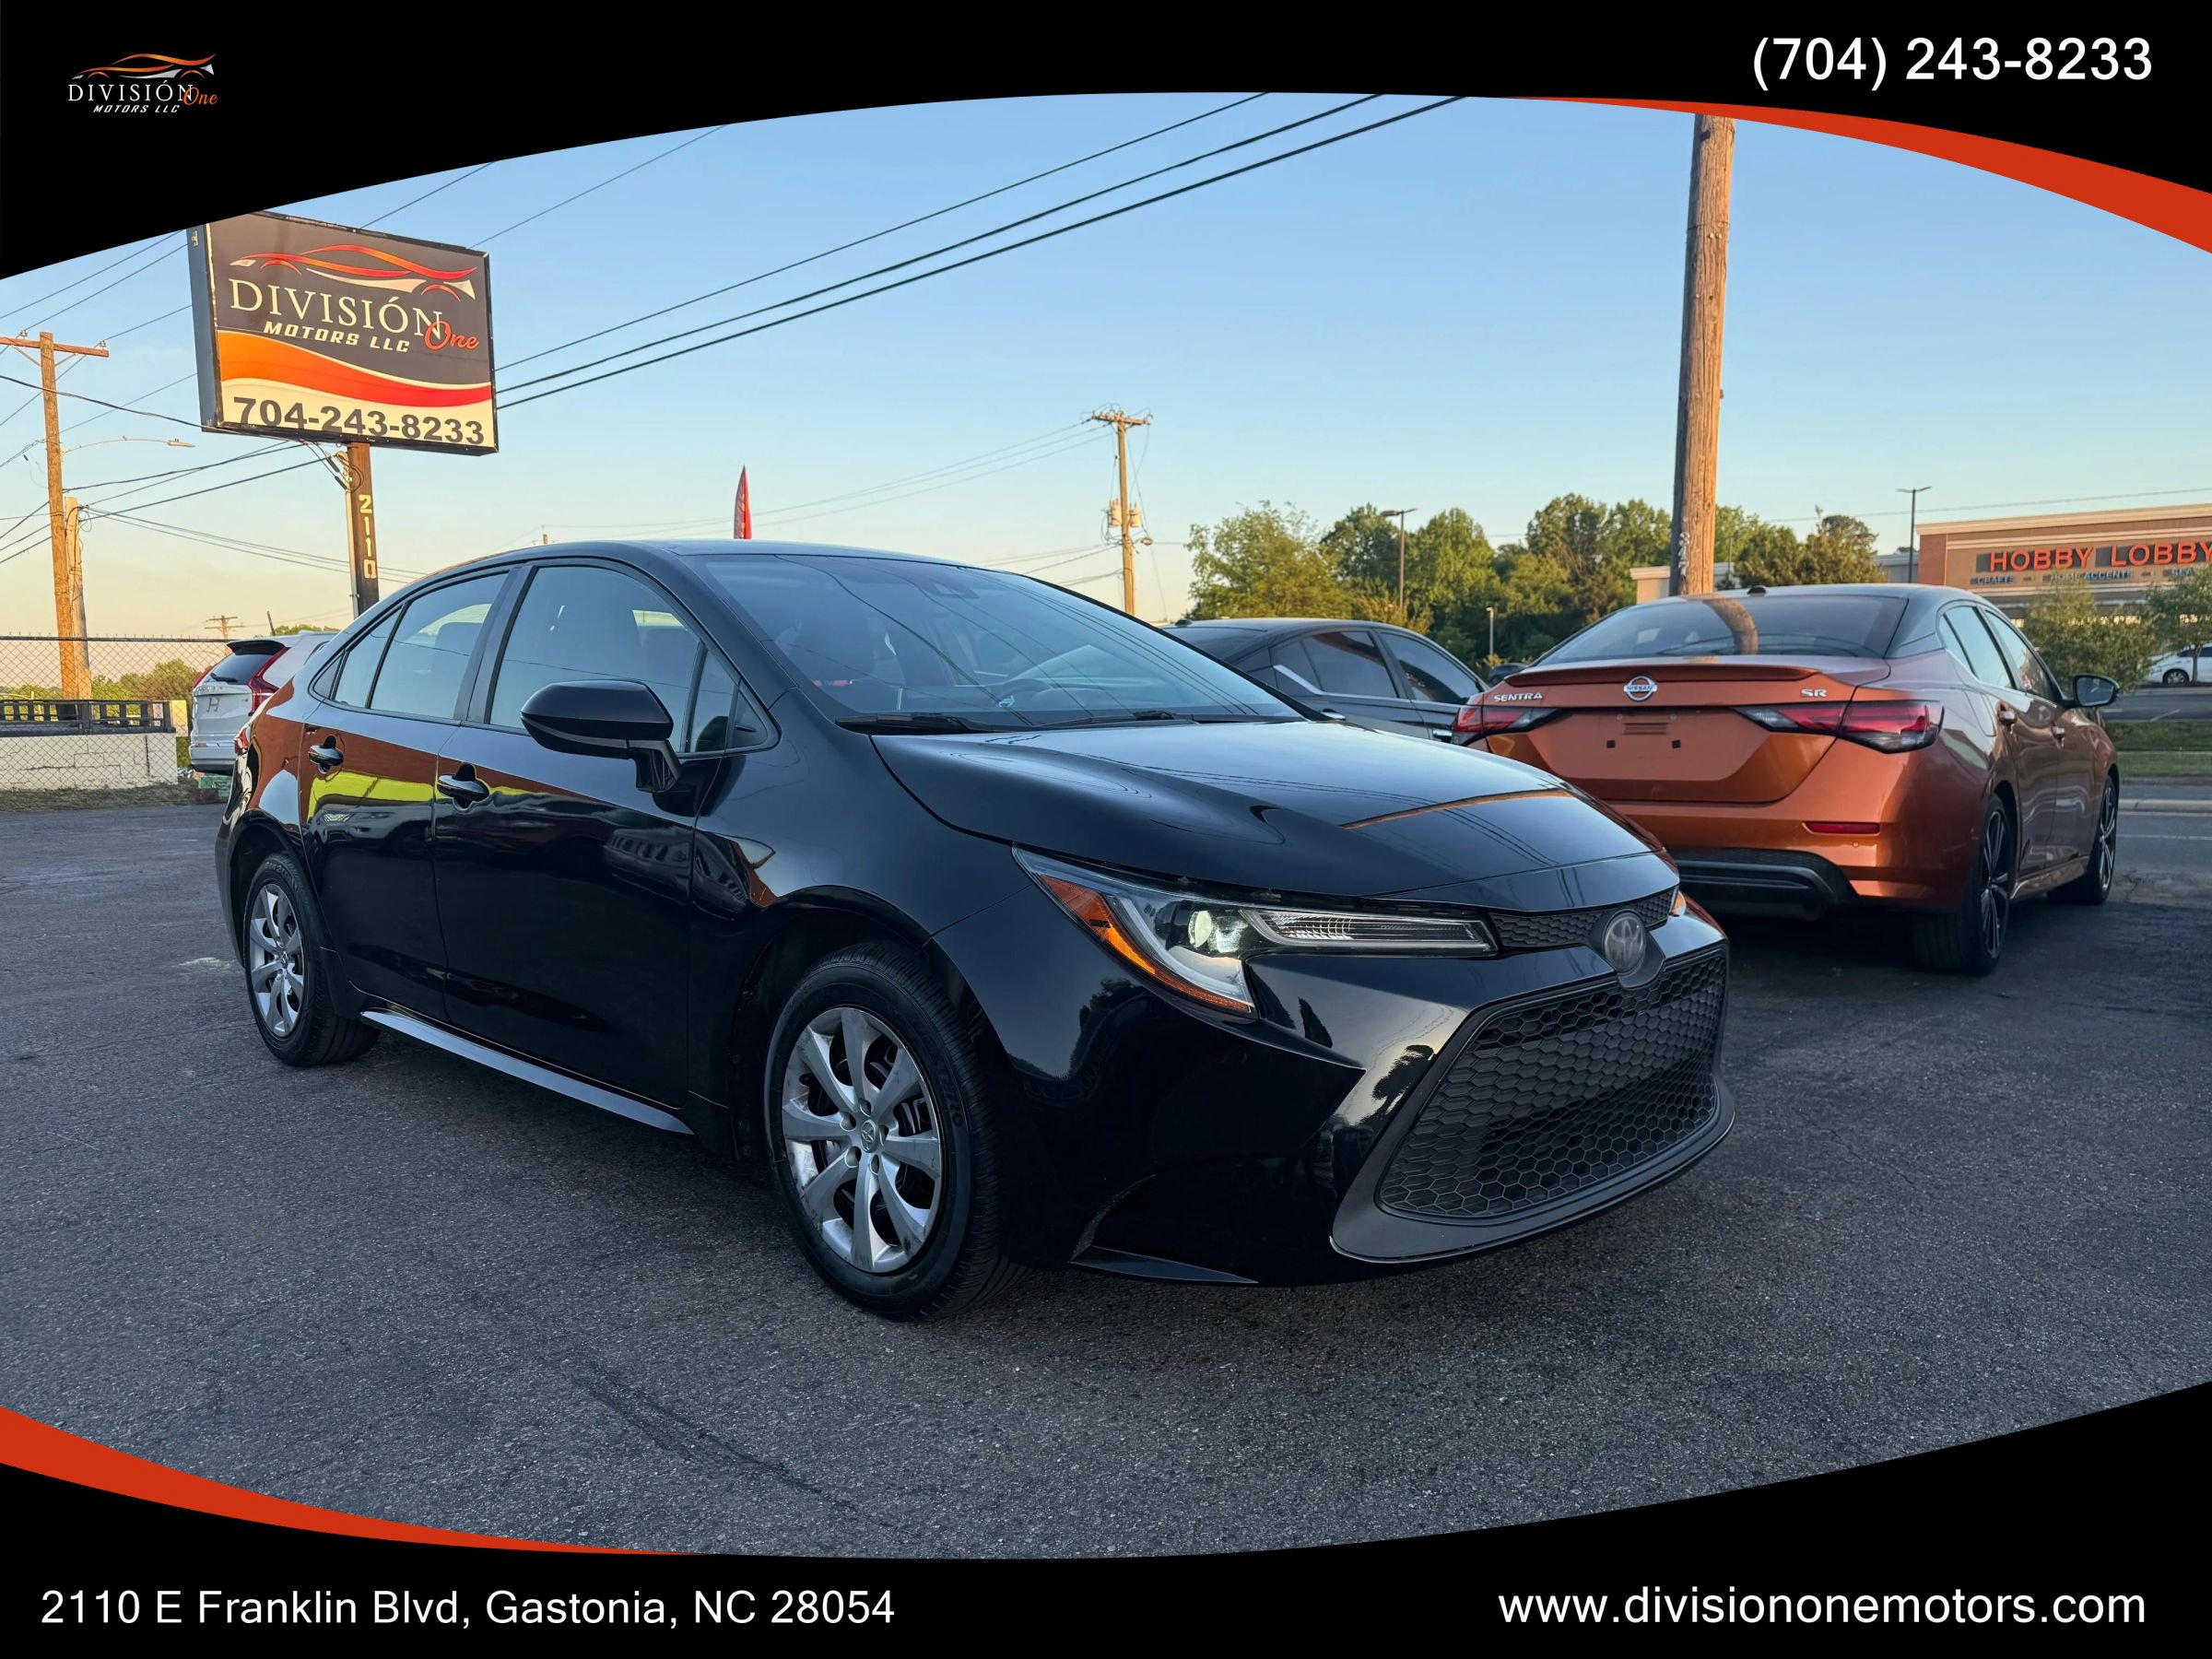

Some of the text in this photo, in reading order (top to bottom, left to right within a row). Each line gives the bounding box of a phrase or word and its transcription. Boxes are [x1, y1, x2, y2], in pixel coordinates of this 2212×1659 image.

[229, 277, 479, 350] DIVISIÓN One
[264, 321, 410, 353] MOTORS LLC
[233, 396, 485, 445] 704-243-8233
[359, 494, 377, 579] 2110
[1991, 540, 2212, 571] HOBBY LOBBY
[1493, 691, 1544, 703] SENTRA
[1801, 688, 1828, 699] SR
